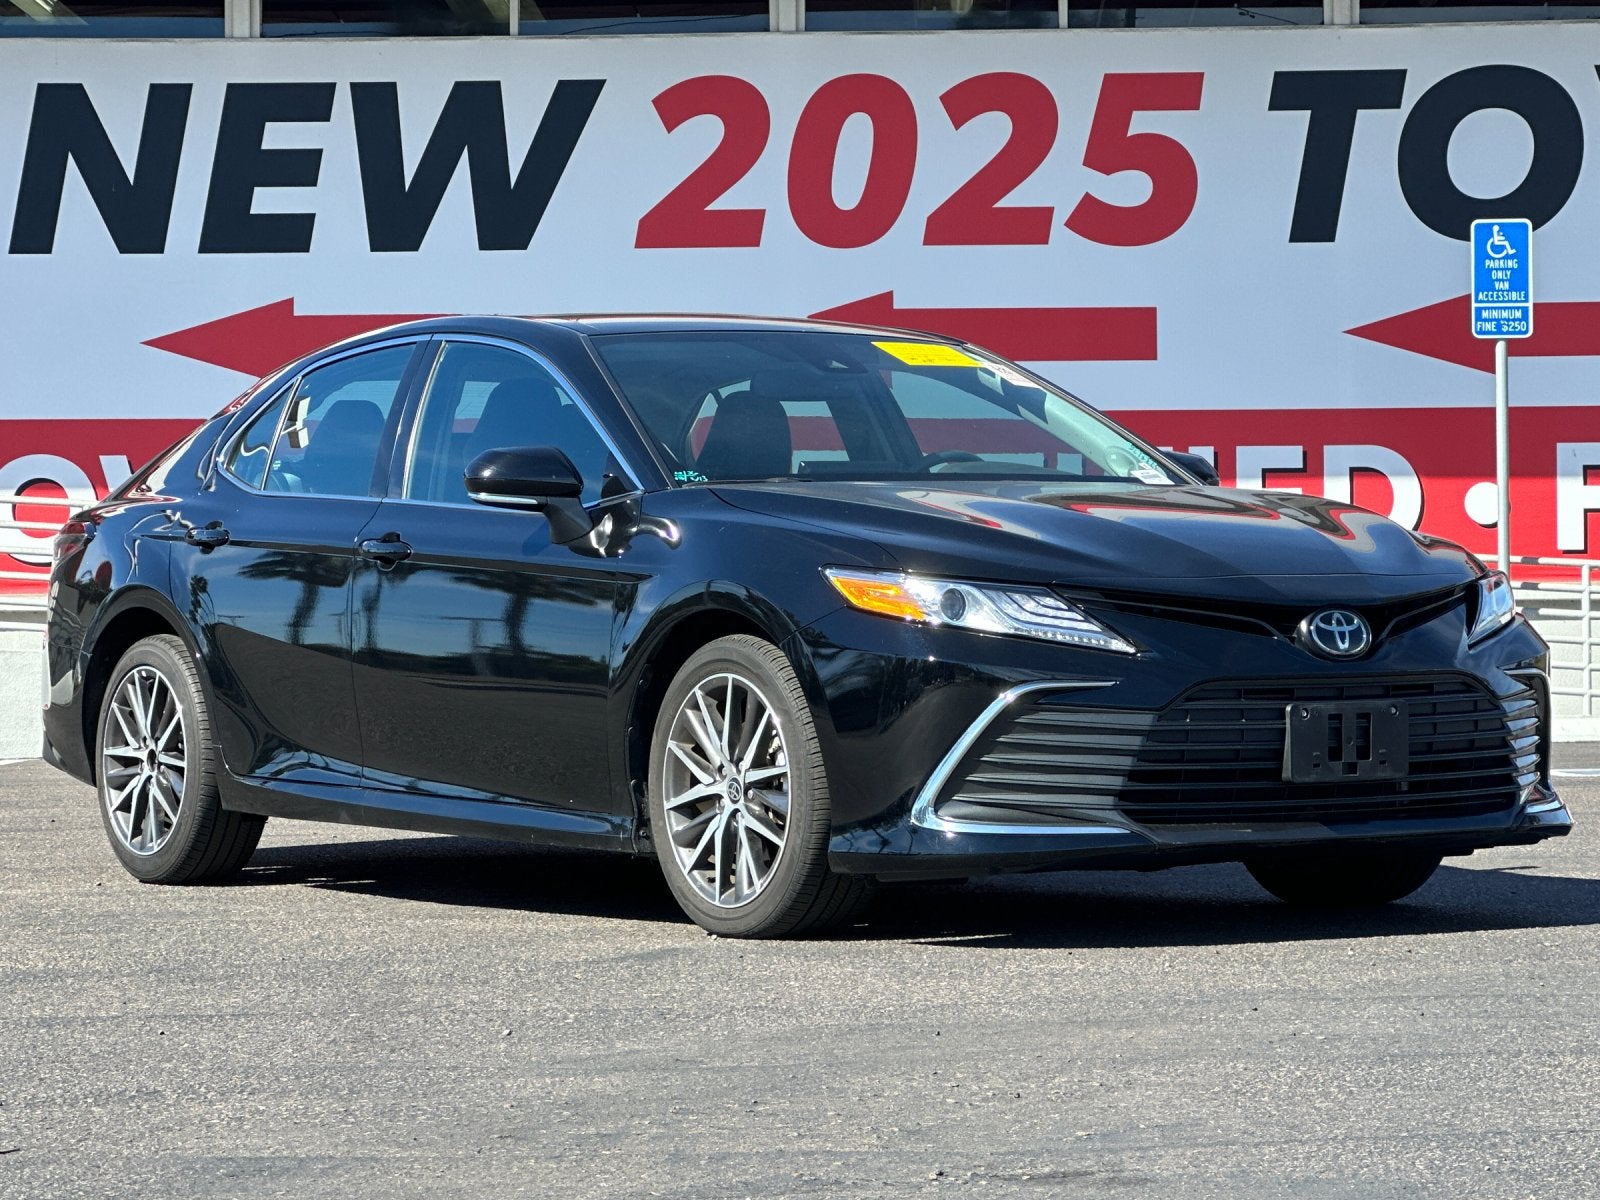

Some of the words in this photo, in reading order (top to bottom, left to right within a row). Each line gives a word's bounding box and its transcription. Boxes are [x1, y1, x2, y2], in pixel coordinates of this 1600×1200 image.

[9, 79, 607, 254] NEW
[634, 71, 1205, 249] 2025
[1268, 64, 1600, 243] TO
[1485, 259, 1518, 268] PARKING
[1491, 270, 1511, 279] ONLY
[1494, 281, 1509, 290] VAN
[1478, 291, 1526, 300] ACCESSIBLE
[1482, 309, 1522, 319] MINIMUM
[1477, 321, 1497, 331] FINE
[1500, 320, 1527, 332] $250
